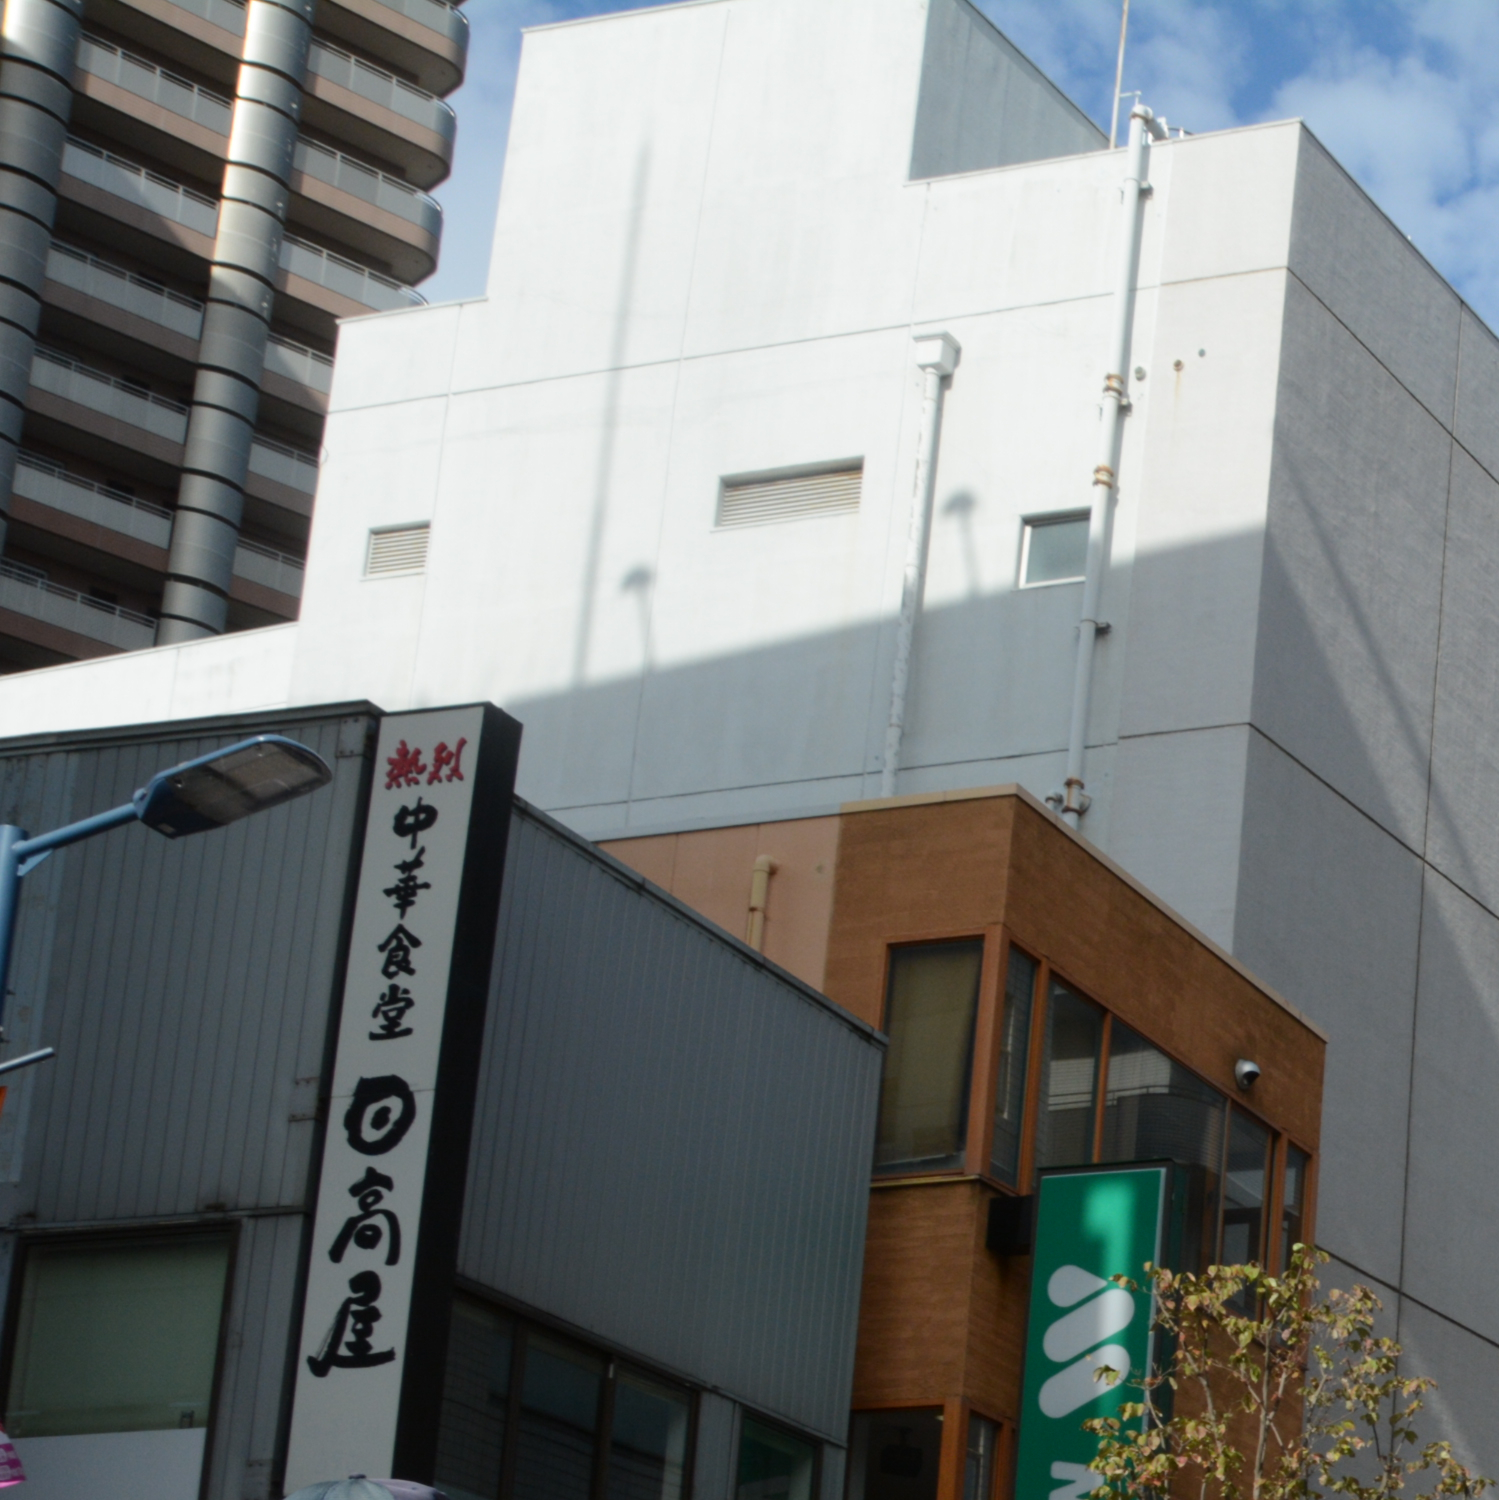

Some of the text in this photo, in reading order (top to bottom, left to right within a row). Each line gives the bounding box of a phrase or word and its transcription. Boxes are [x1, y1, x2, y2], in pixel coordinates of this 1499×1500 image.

[385, 737, 467, 790] 熱烈
[369, 796, 437, 1041] 中華食堂
